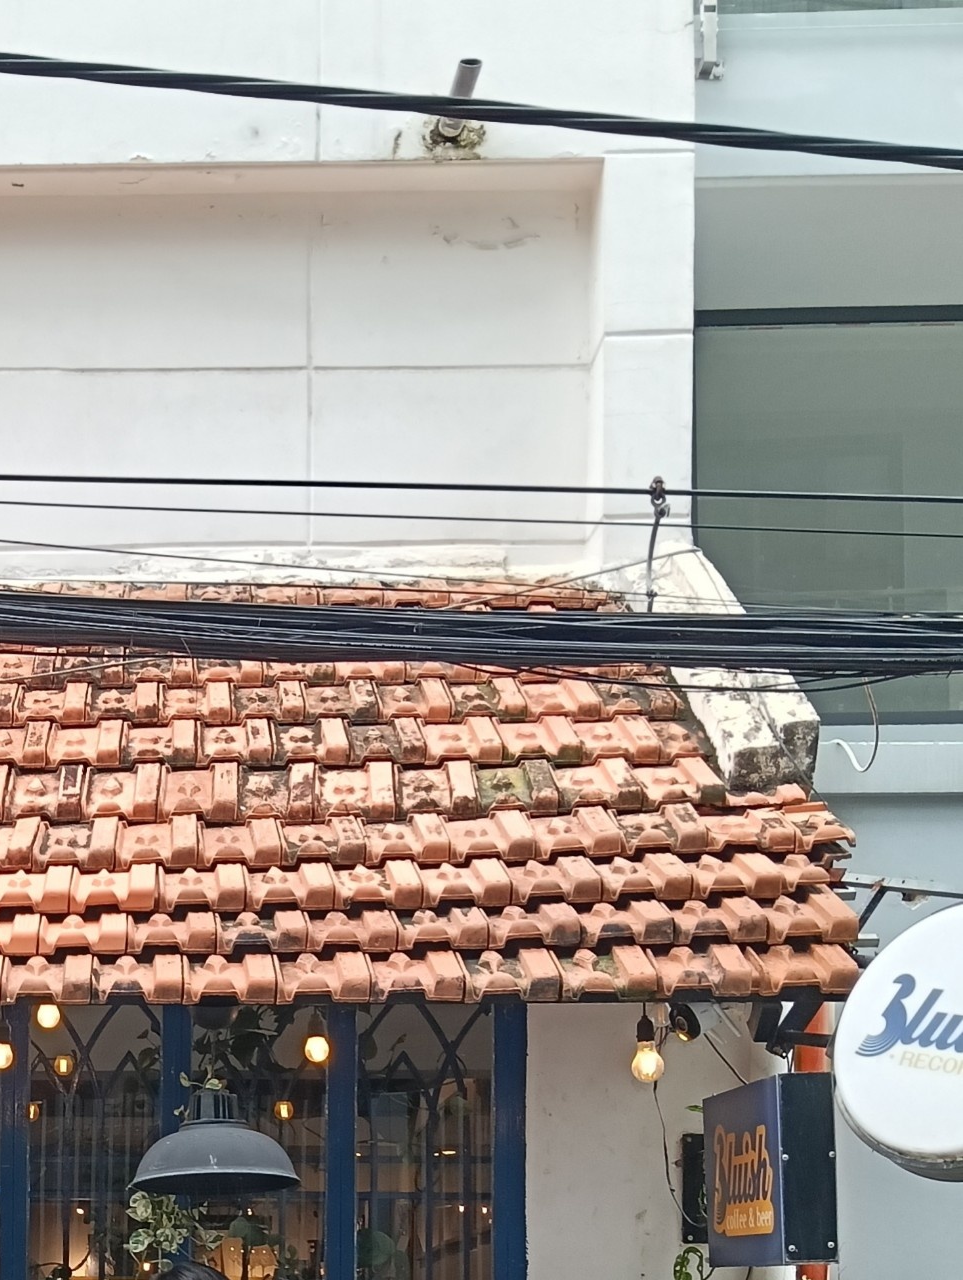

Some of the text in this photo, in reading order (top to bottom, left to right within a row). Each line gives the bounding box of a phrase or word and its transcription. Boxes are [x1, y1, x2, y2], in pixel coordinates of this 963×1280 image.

[855, 973, 963, 1057] Blu
[714, 1124, 773, 1227] Bluish
[726, 1208, 747, 1230] coffee
[748, 1207, 755, 1229] &
